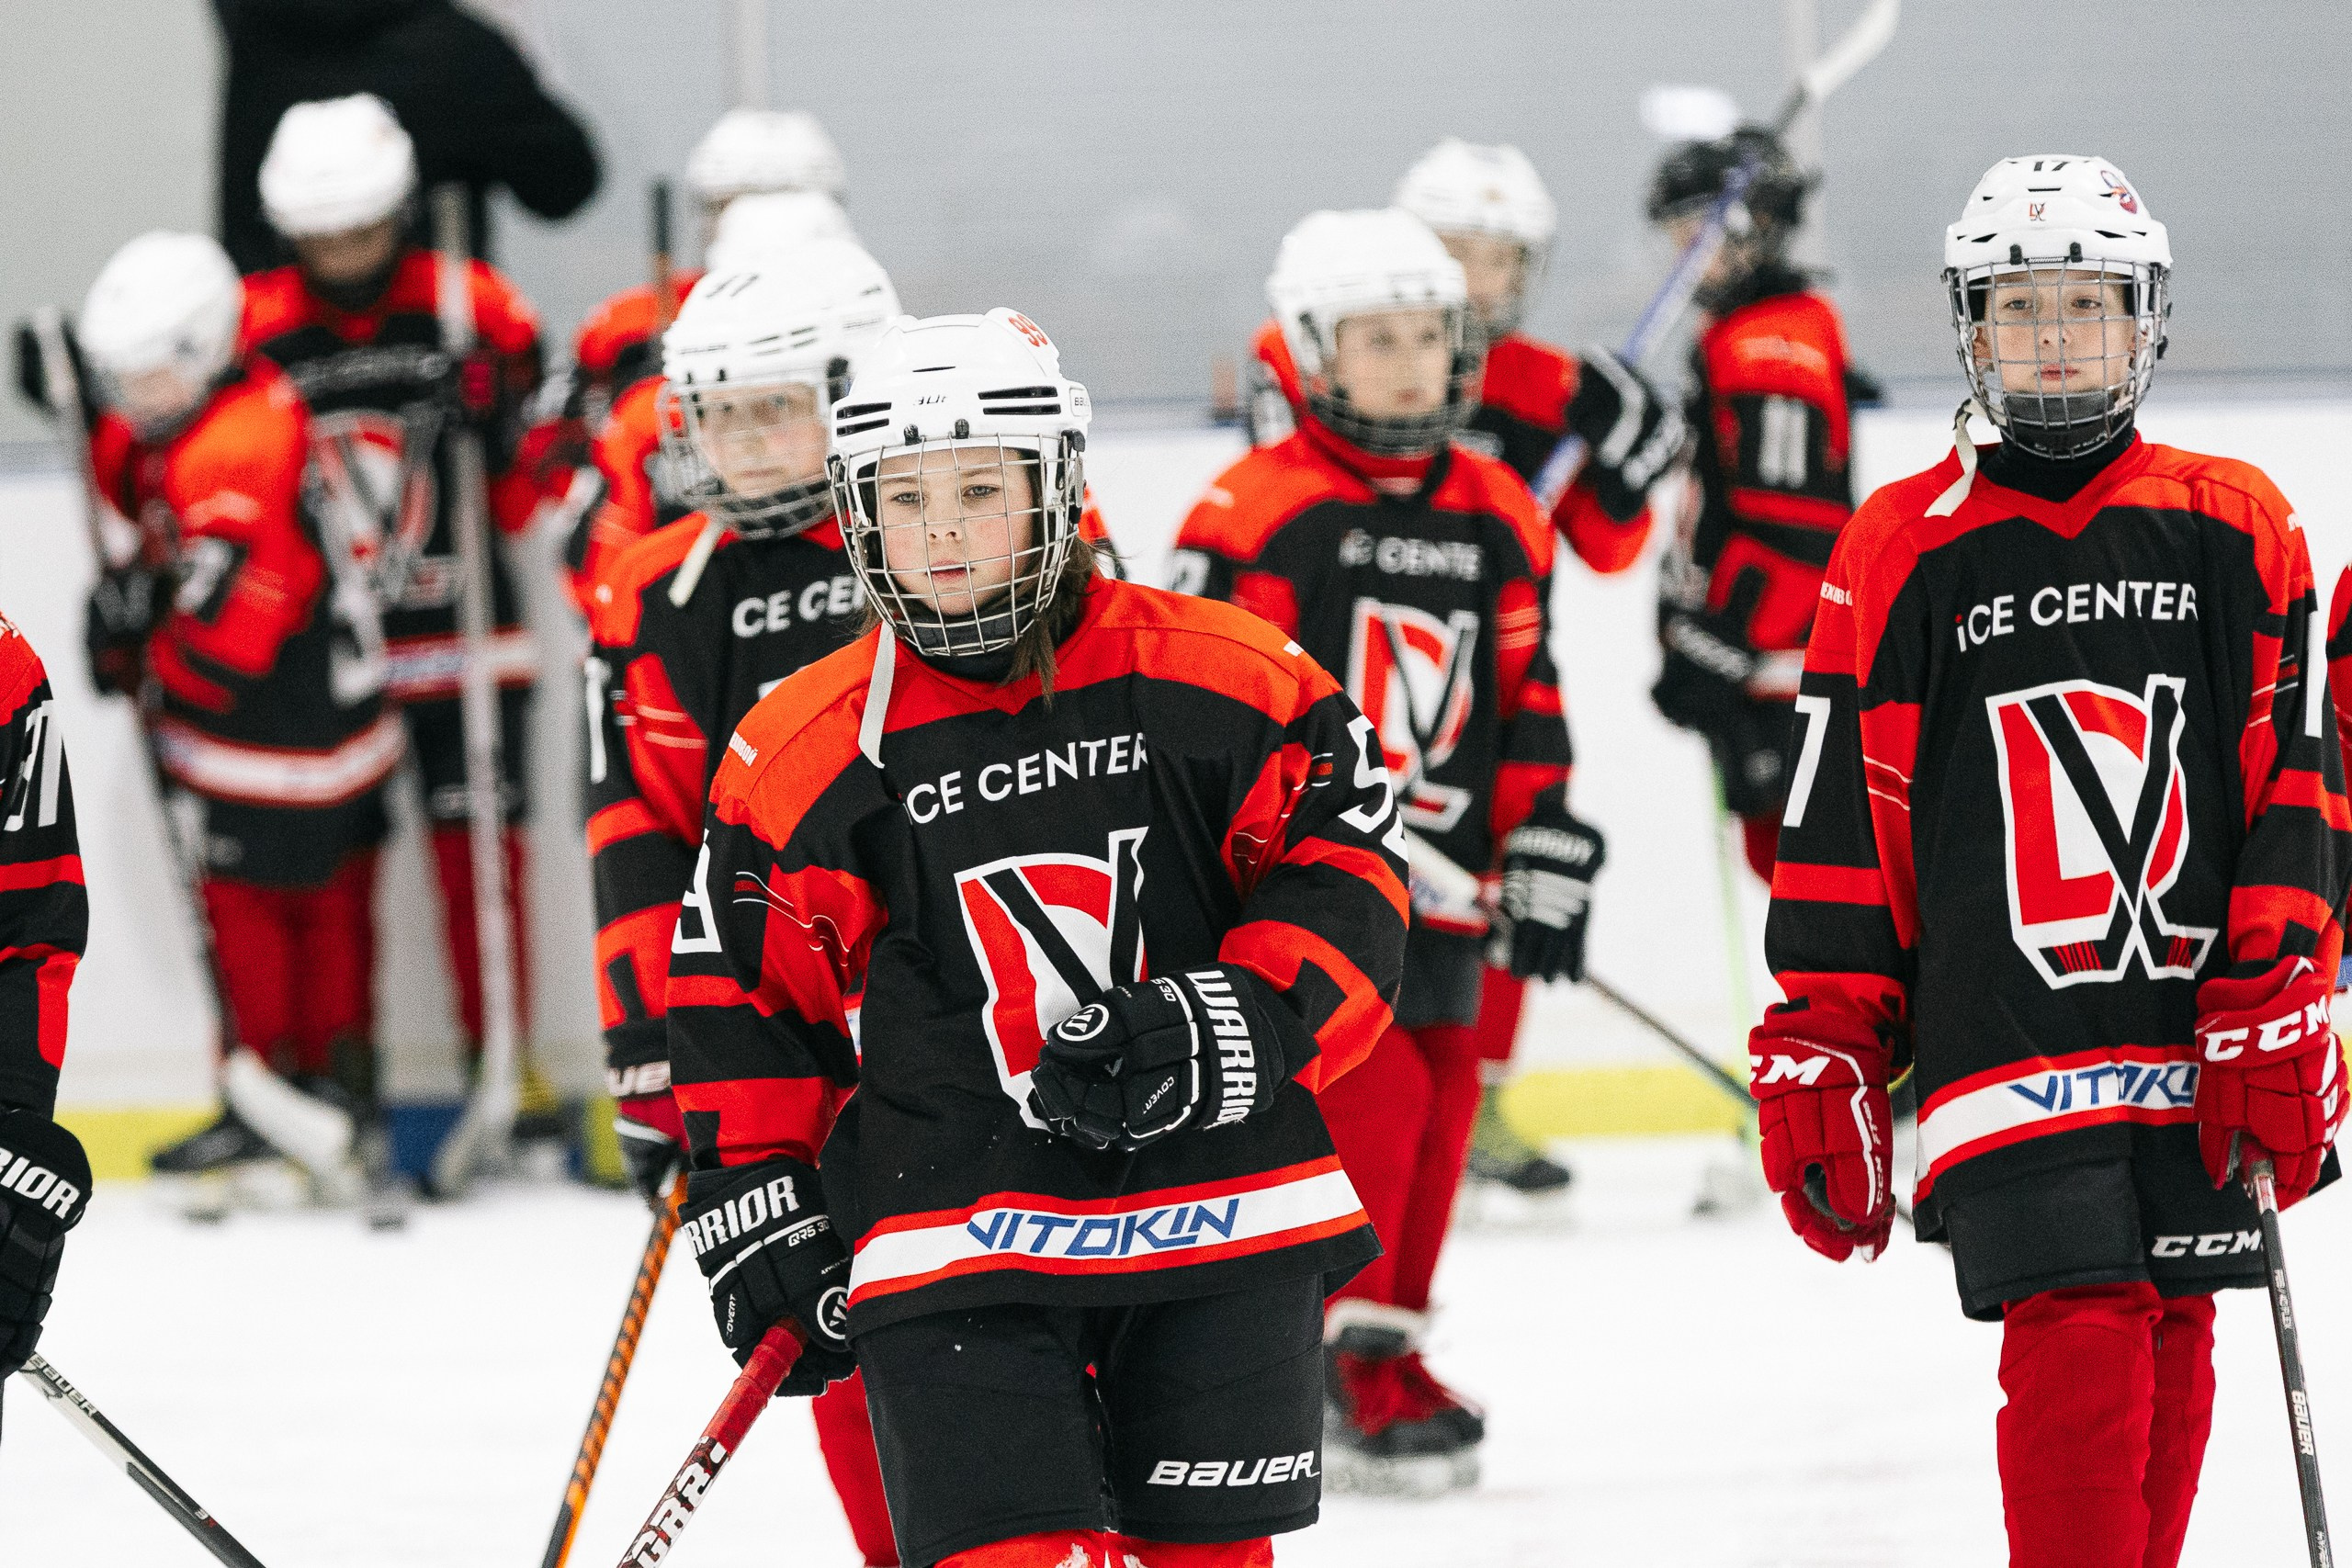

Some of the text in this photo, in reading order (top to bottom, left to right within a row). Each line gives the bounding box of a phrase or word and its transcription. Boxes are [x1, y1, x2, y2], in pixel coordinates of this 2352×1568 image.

[897, 770, 964, 825] CE
[2205, 995, 2330, 1063] CCM
[967, 1198, 1240, 1258] VITOKIN
[2151, 1228, 2264, 1258] CCM
